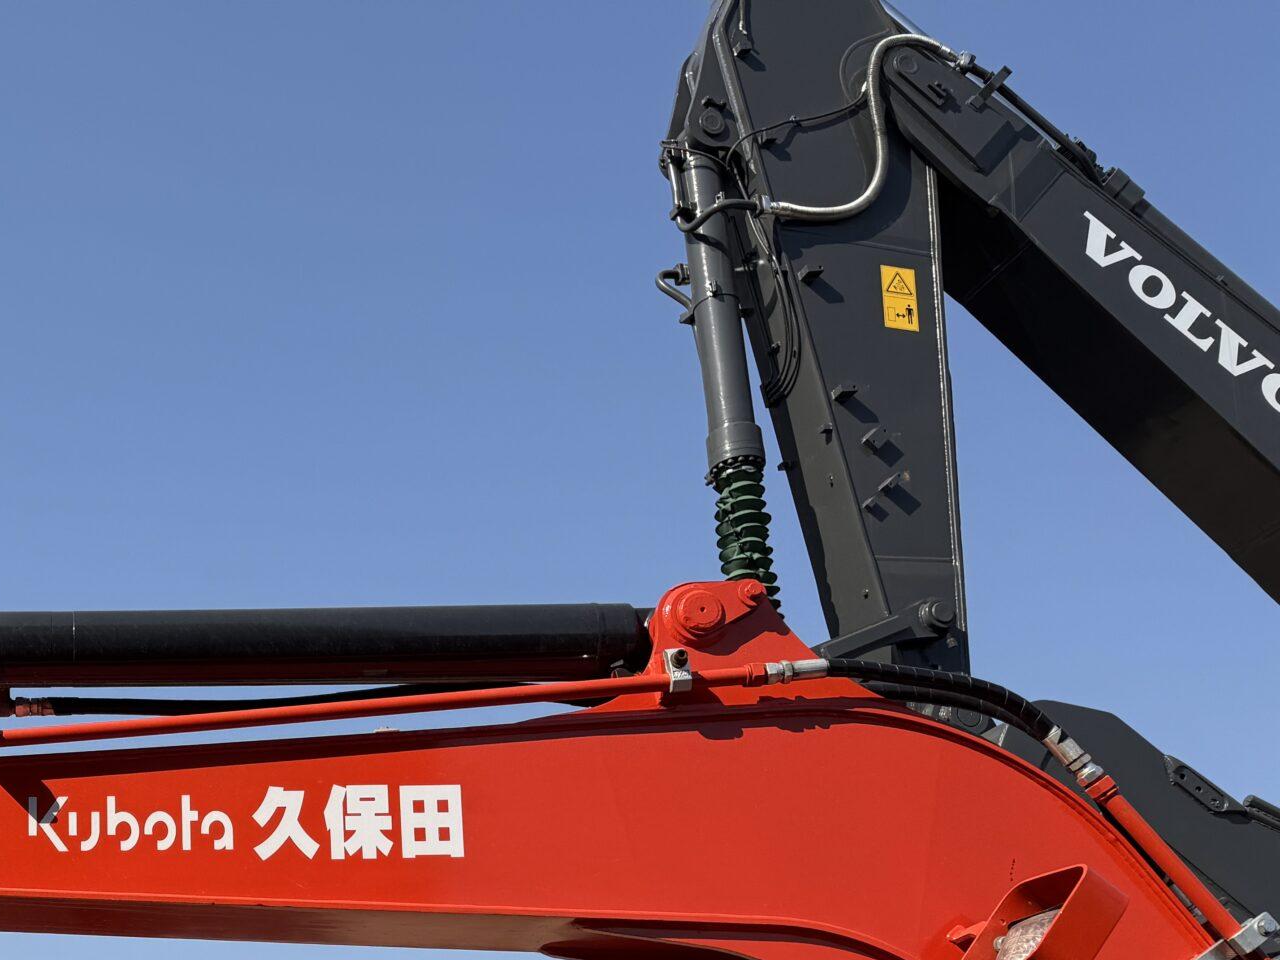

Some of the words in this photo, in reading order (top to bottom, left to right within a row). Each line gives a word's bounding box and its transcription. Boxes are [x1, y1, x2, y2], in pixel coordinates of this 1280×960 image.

[27, 794, 235, 852] Kubota
[251, 783, 466, 860] 久保田
